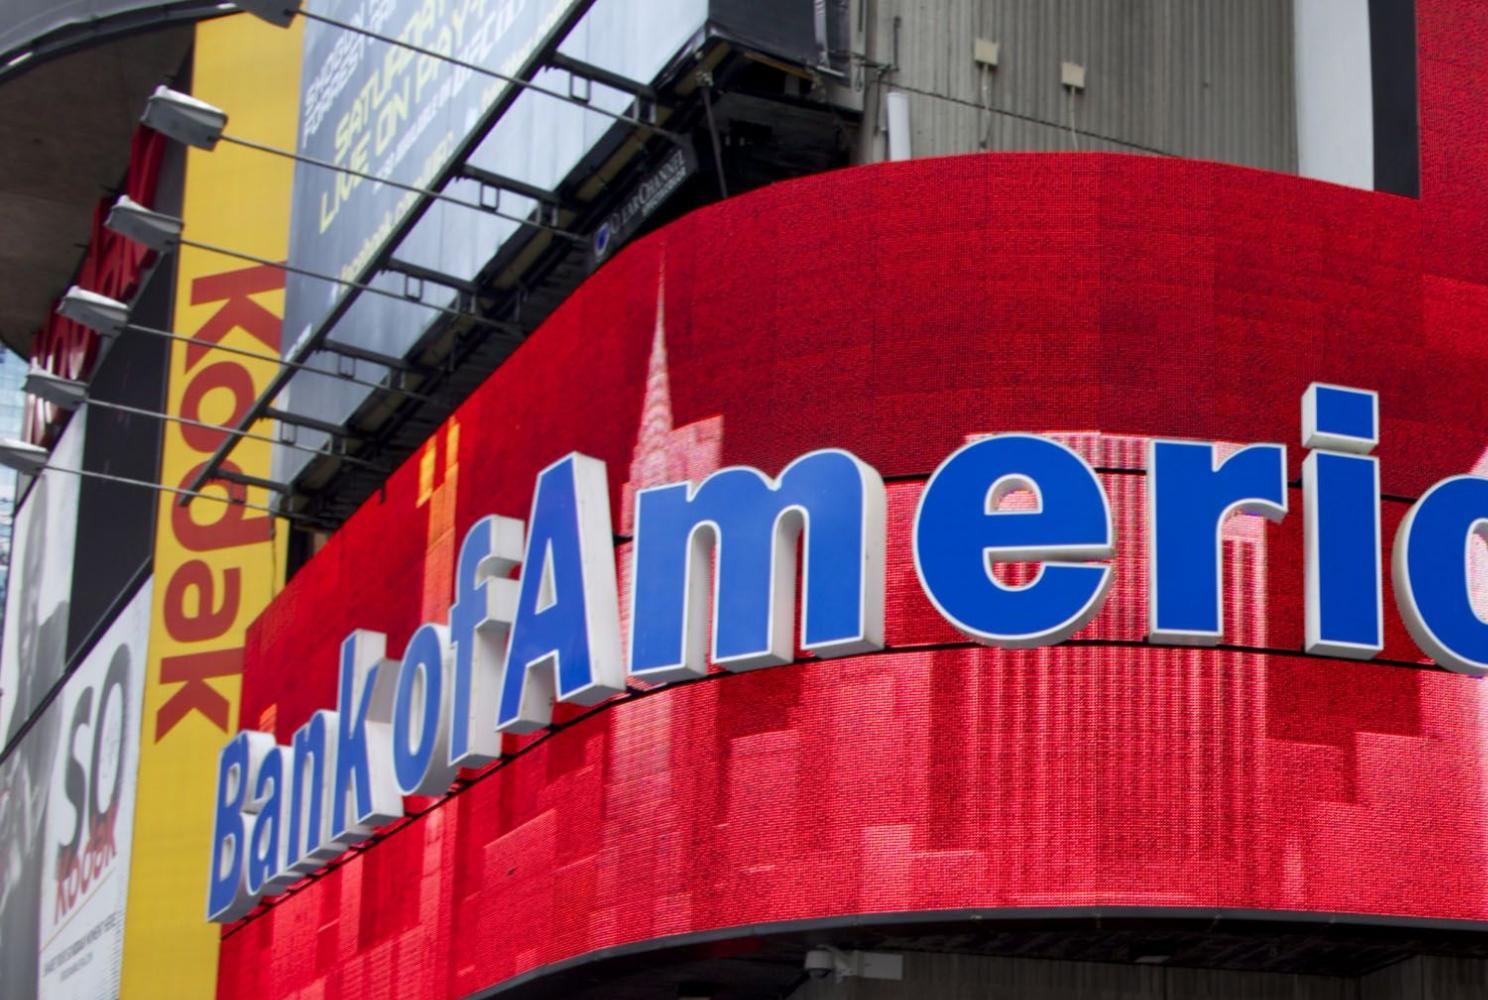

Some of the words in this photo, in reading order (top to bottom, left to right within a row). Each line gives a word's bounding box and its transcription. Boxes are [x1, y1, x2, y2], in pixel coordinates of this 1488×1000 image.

[154, 260, 288, 745] Kodak
[207, 628, 403, 922] Bank
[393, 513, 524, 797] of
